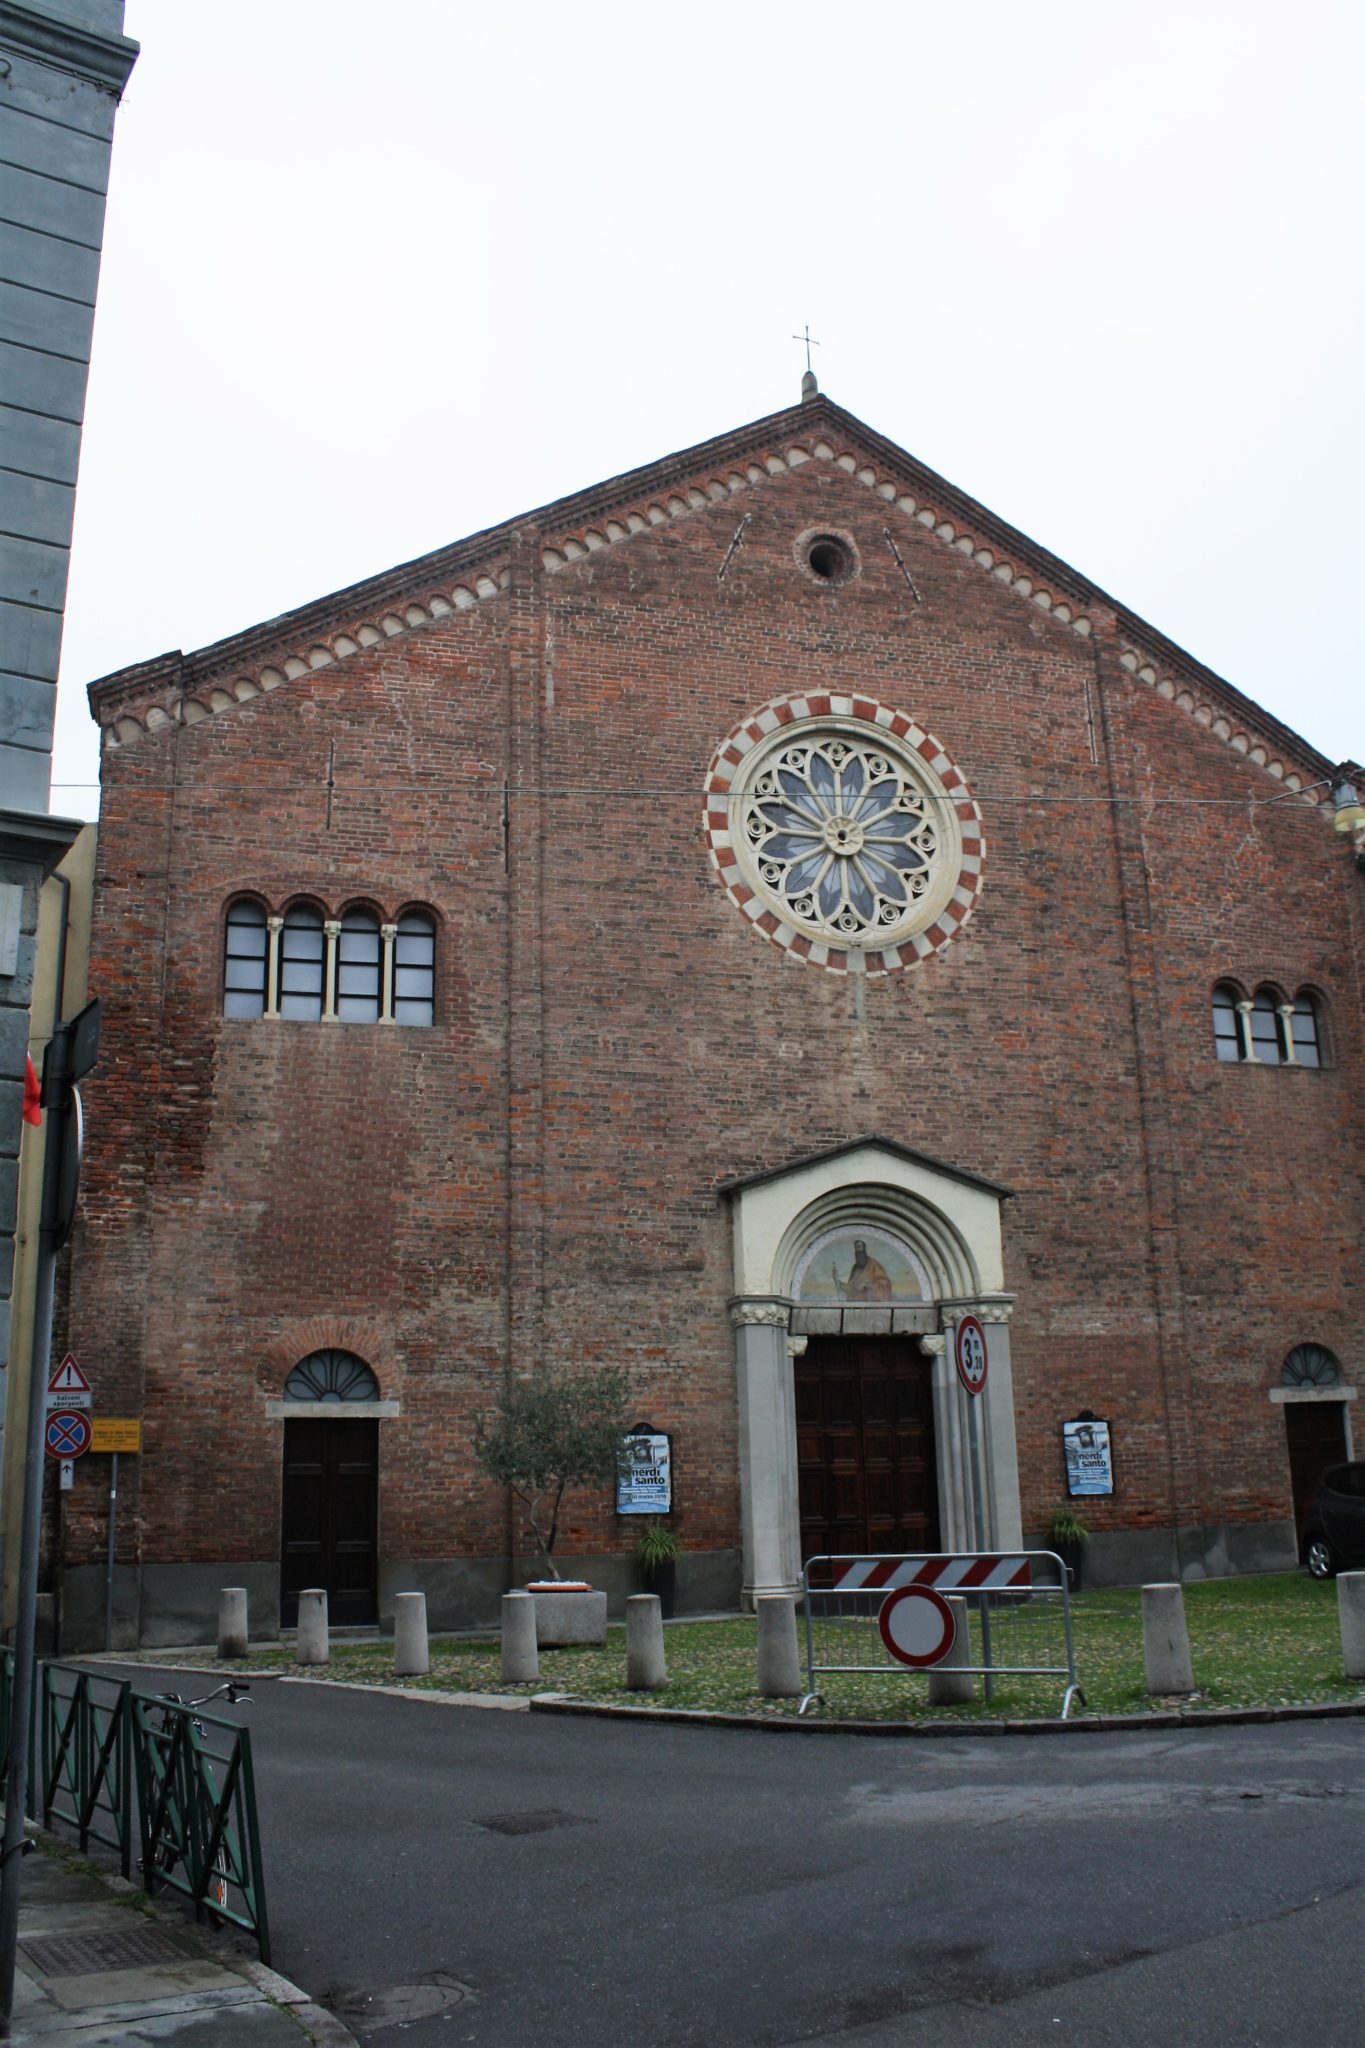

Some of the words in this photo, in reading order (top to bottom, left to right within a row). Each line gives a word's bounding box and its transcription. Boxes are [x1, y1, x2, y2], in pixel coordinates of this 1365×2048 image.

[964, 1338, 972, 1369] 3
[1081, 1459, 1107, 1468] santo
[635, 1476, 665, 1484] santo
